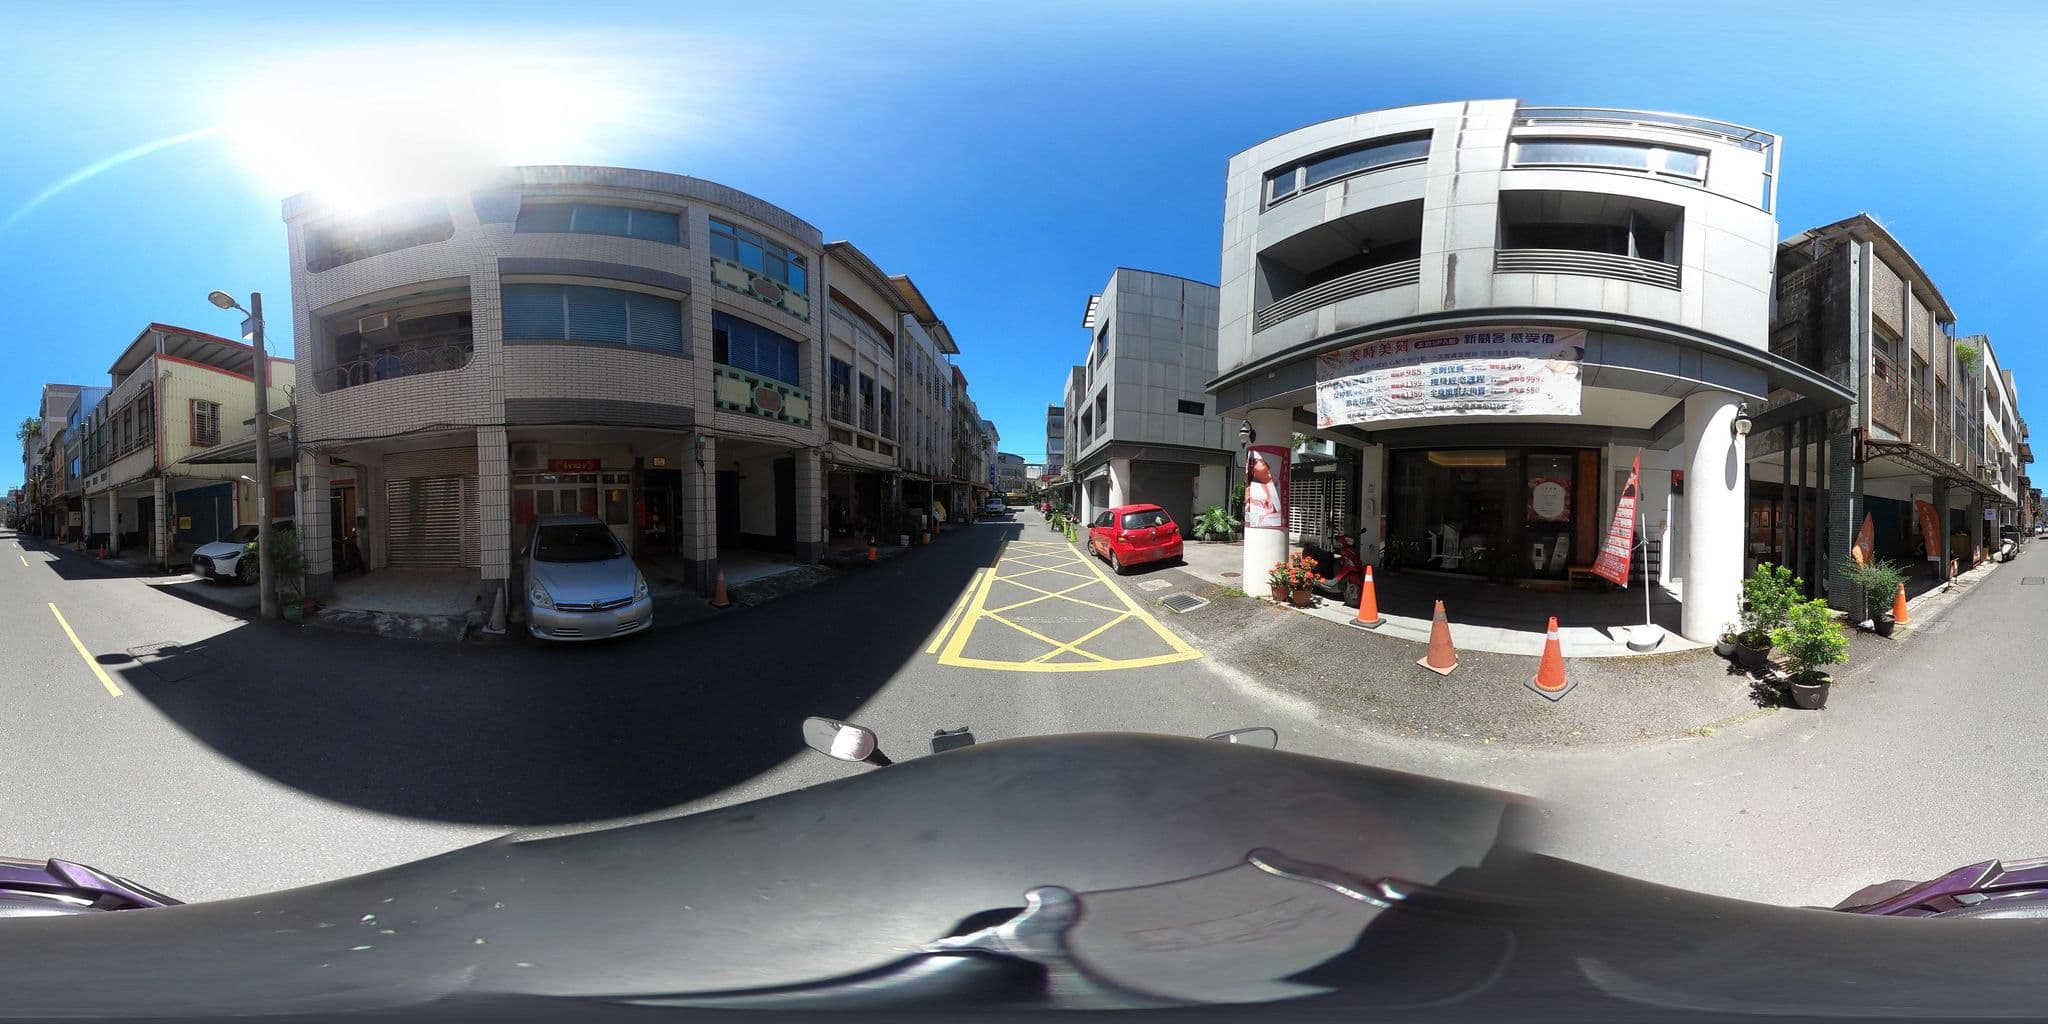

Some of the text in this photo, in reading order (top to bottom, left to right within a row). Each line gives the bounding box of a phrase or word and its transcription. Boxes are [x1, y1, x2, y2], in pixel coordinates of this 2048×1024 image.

[1463, 332, 1506, 344] 新顧客
[1348, 340, 1409, 362] 美時美刻
